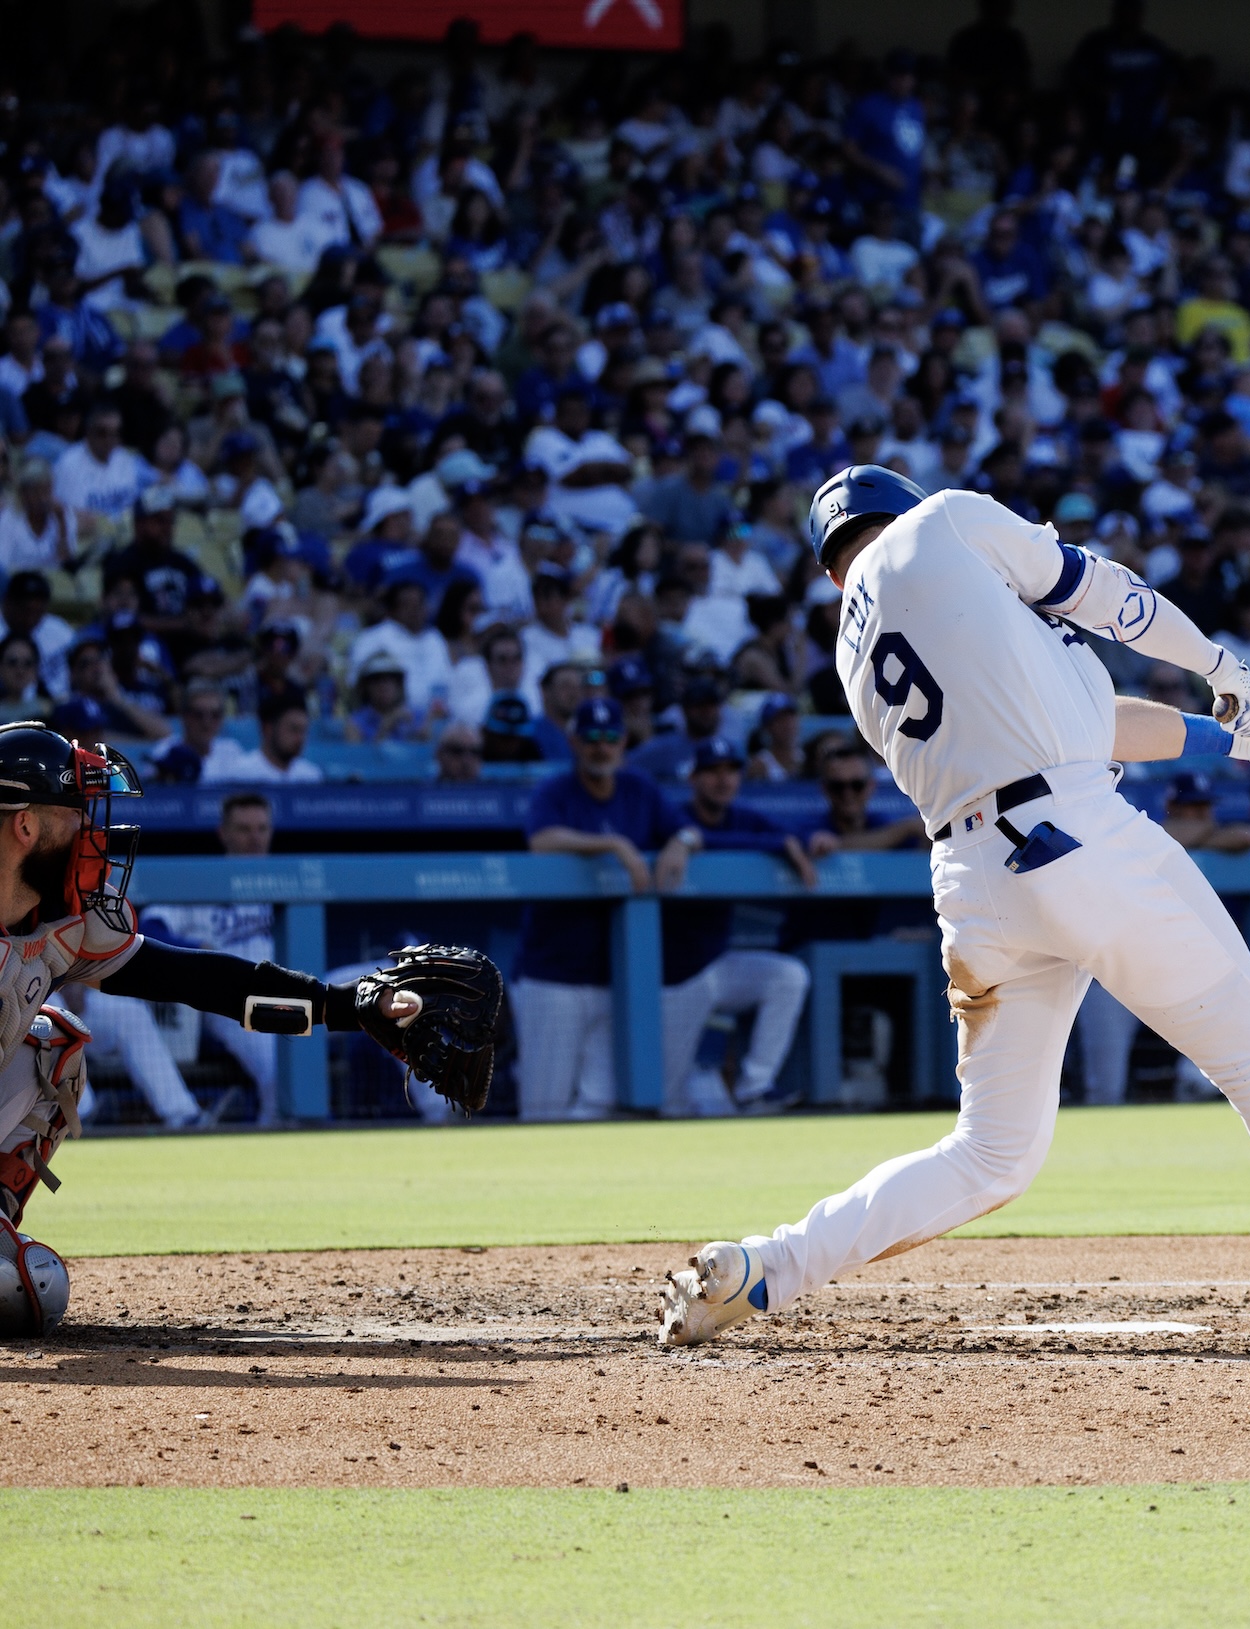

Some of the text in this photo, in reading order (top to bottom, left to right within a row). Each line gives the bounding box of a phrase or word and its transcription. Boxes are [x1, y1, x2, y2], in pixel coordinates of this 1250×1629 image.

[828, 501, 840, 517] 9
[844, 573, 875, 654] LUX
[870, 631, 944, 742] 9
